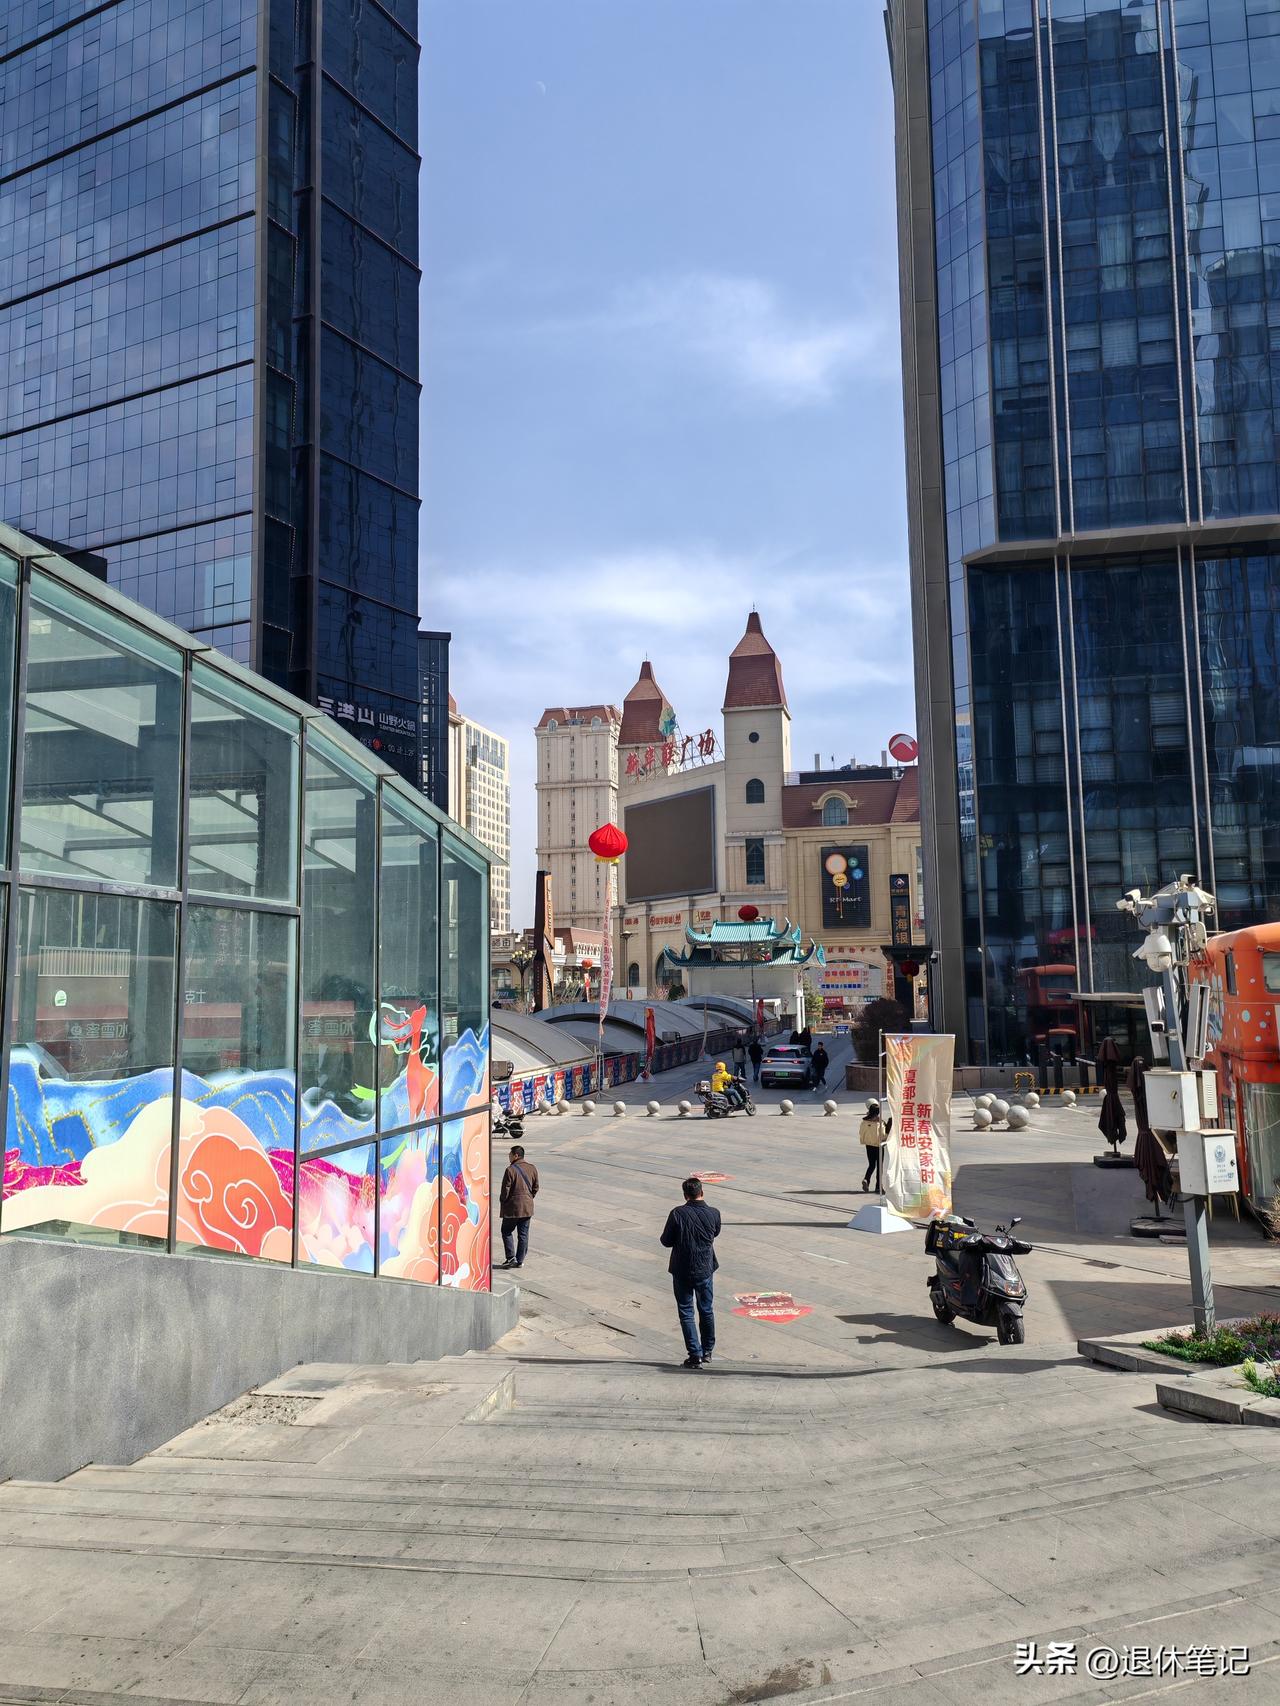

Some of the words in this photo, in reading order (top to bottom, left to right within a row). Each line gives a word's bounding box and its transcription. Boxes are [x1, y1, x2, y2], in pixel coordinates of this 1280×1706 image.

[901, 1069, 917, 1149] 夏都宜居地
[916, 1103, 935, 1185] 新春安家时
